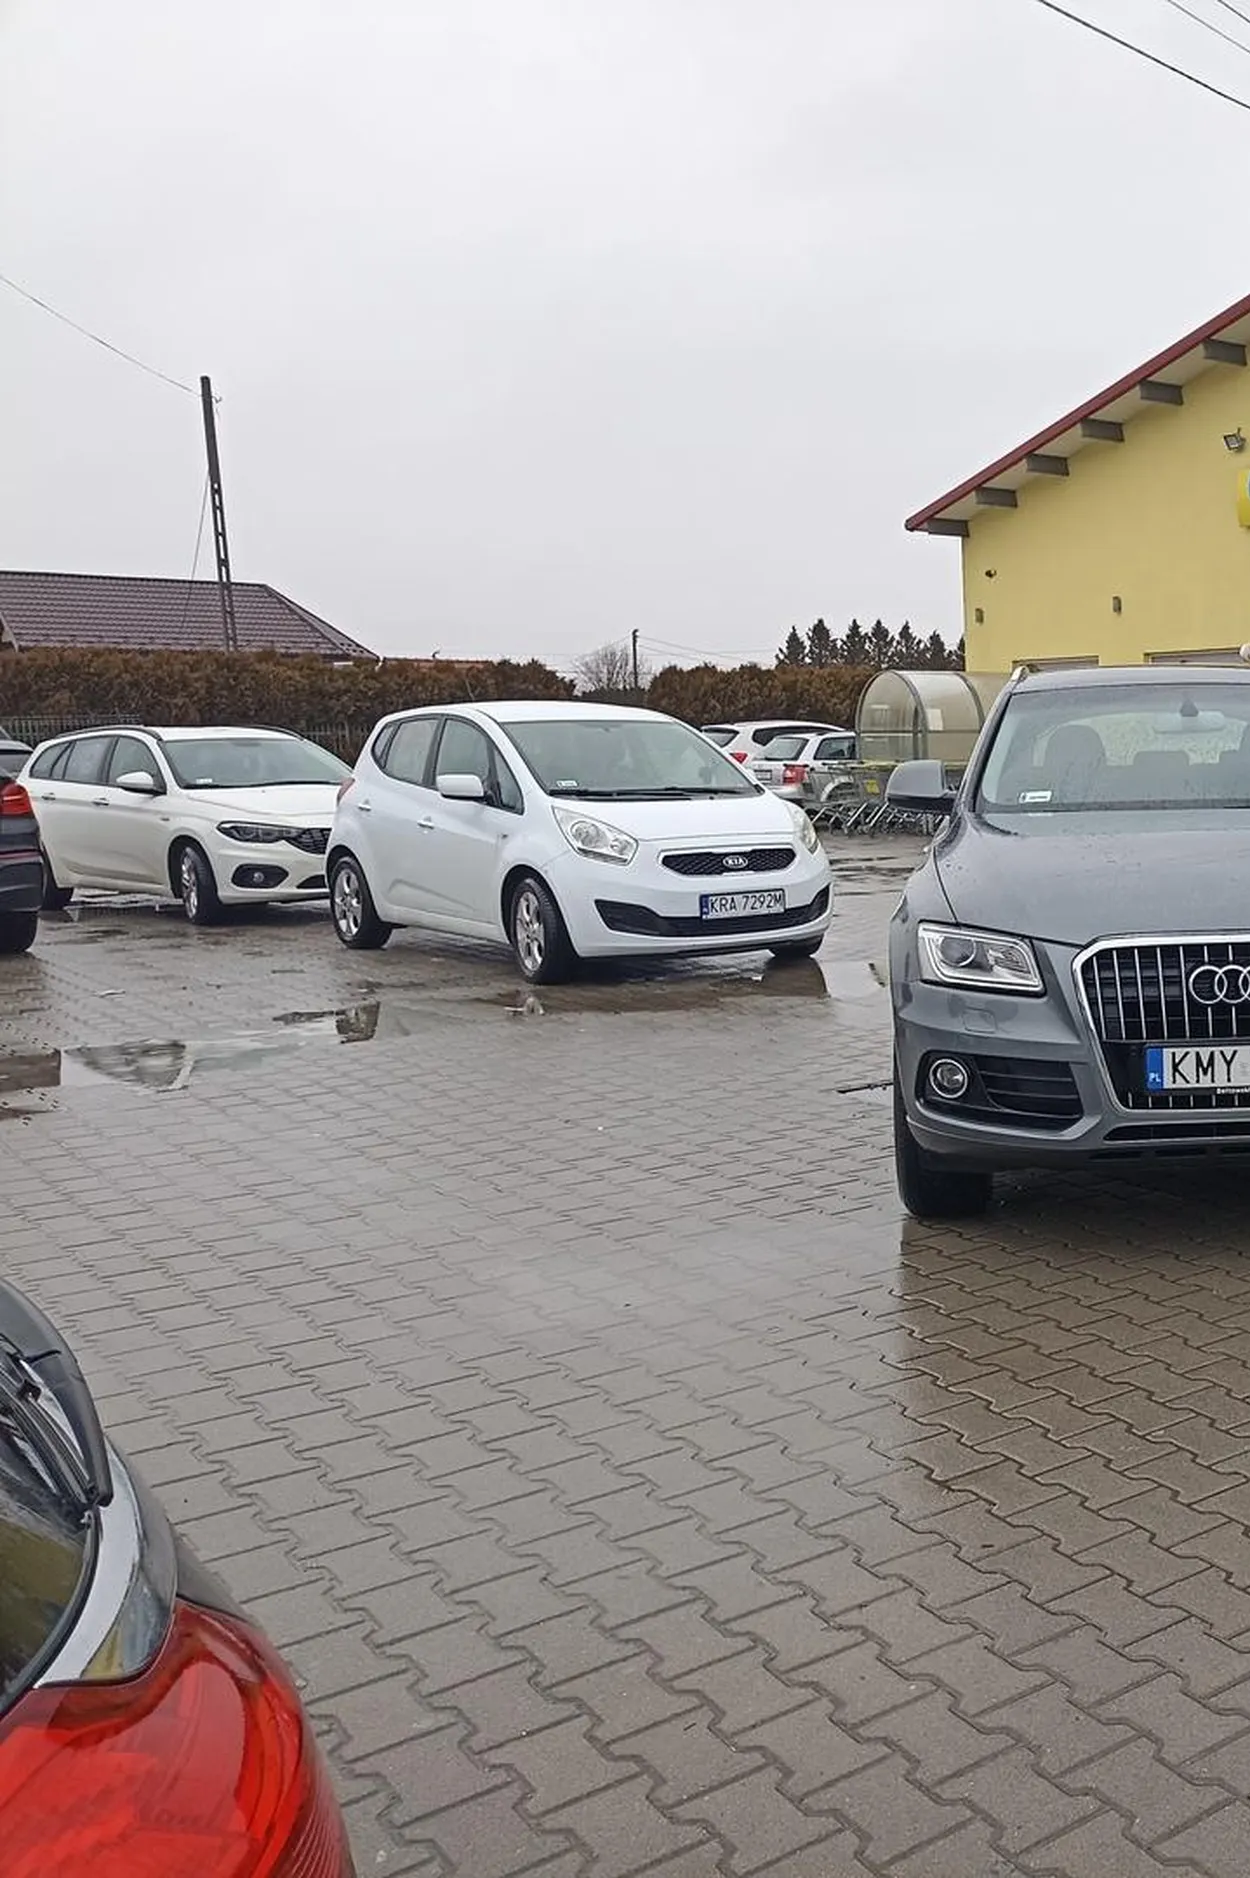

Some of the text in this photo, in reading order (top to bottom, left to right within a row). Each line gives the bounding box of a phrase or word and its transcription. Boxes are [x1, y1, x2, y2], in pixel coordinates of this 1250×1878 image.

[728, 857, 746, 866] KIA
[710, 896, 737, 913] KRA
[1171, 1050, 1238, 1084] KMY
[1150, 1072, 1162, 1082] PL
